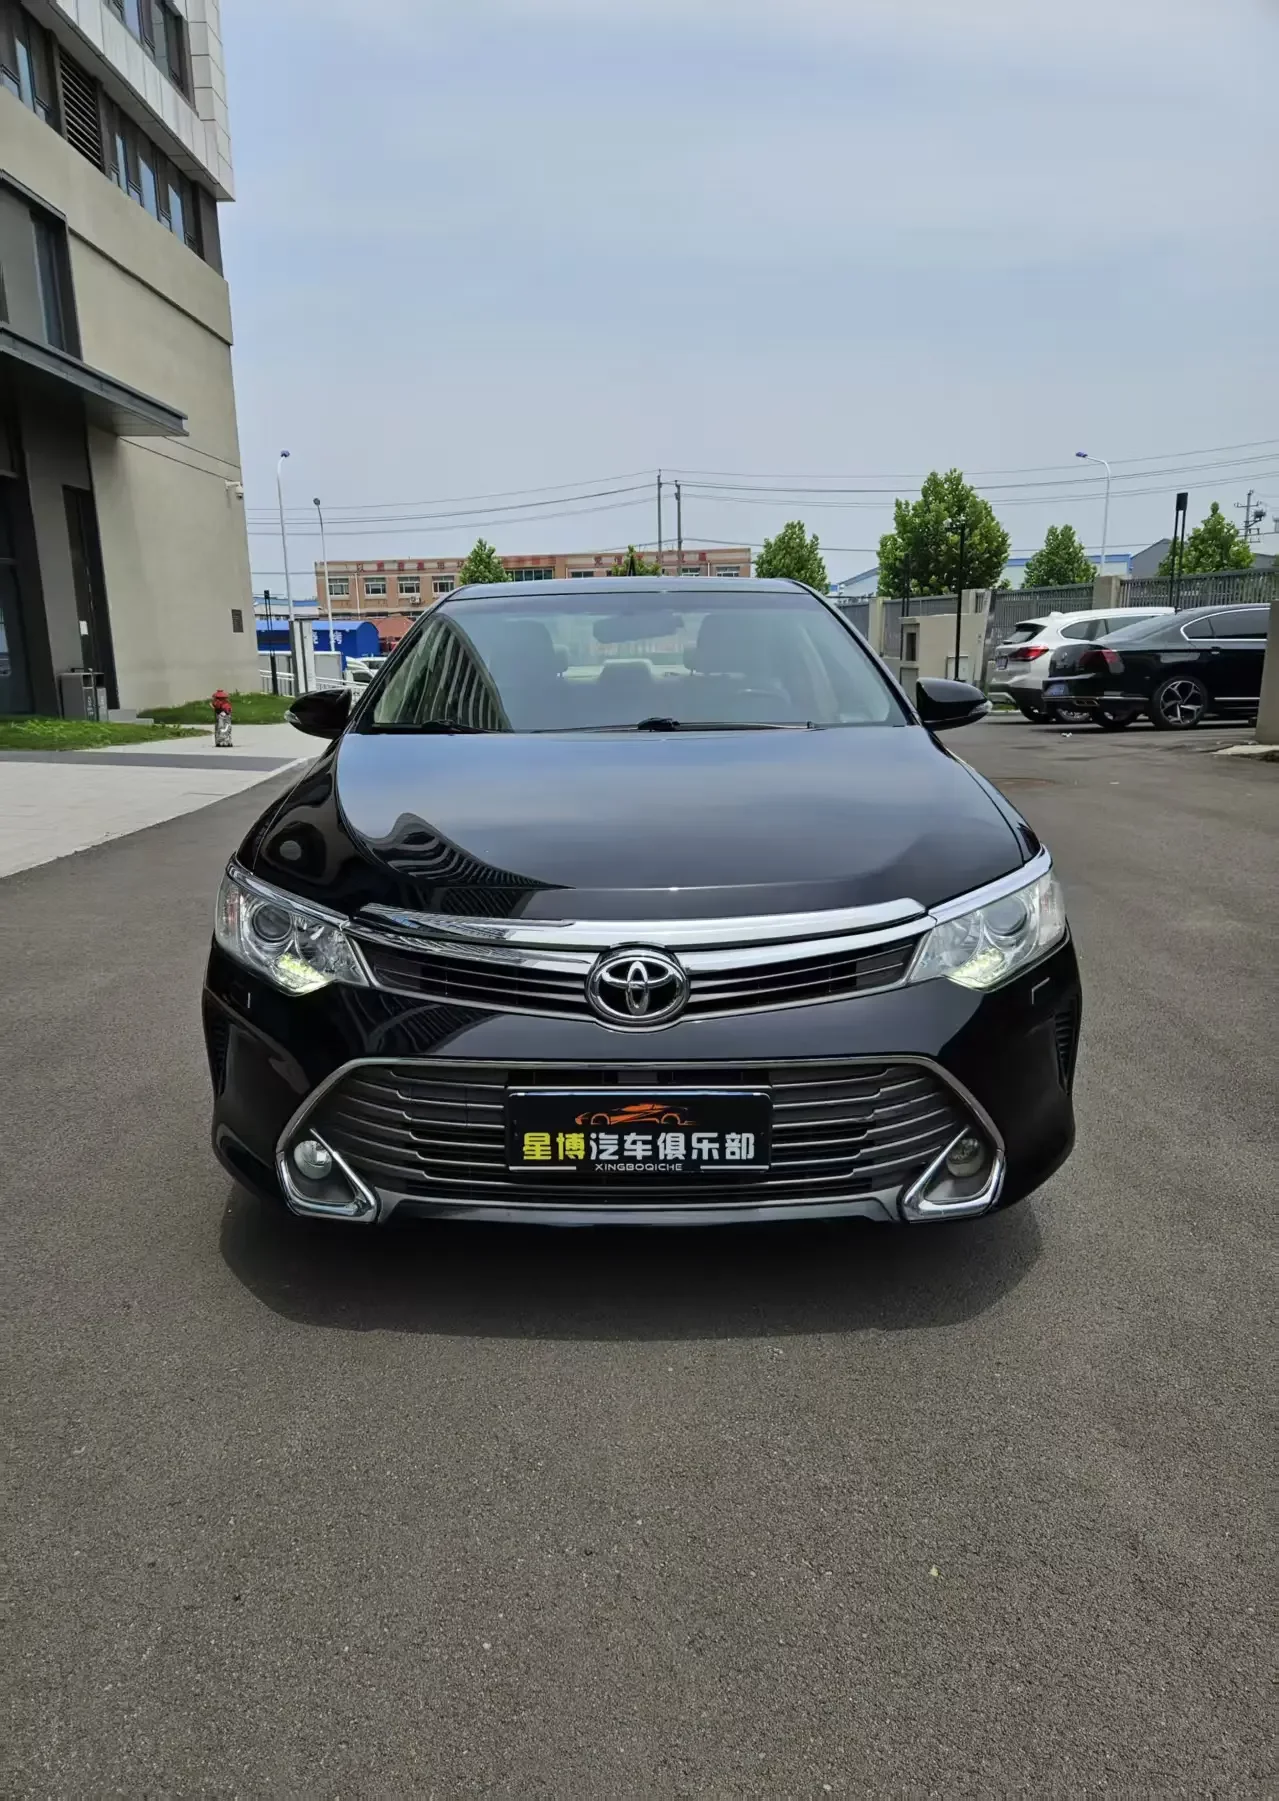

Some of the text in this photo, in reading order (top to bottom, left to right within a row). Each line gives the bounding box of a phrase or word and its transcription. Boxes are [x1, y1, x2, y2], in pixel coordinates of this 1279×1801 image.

[522, 1132, 755, 1160] 星博汽车俱乐部
[594, 1163, 683, 1171] XINGBOQICHE
